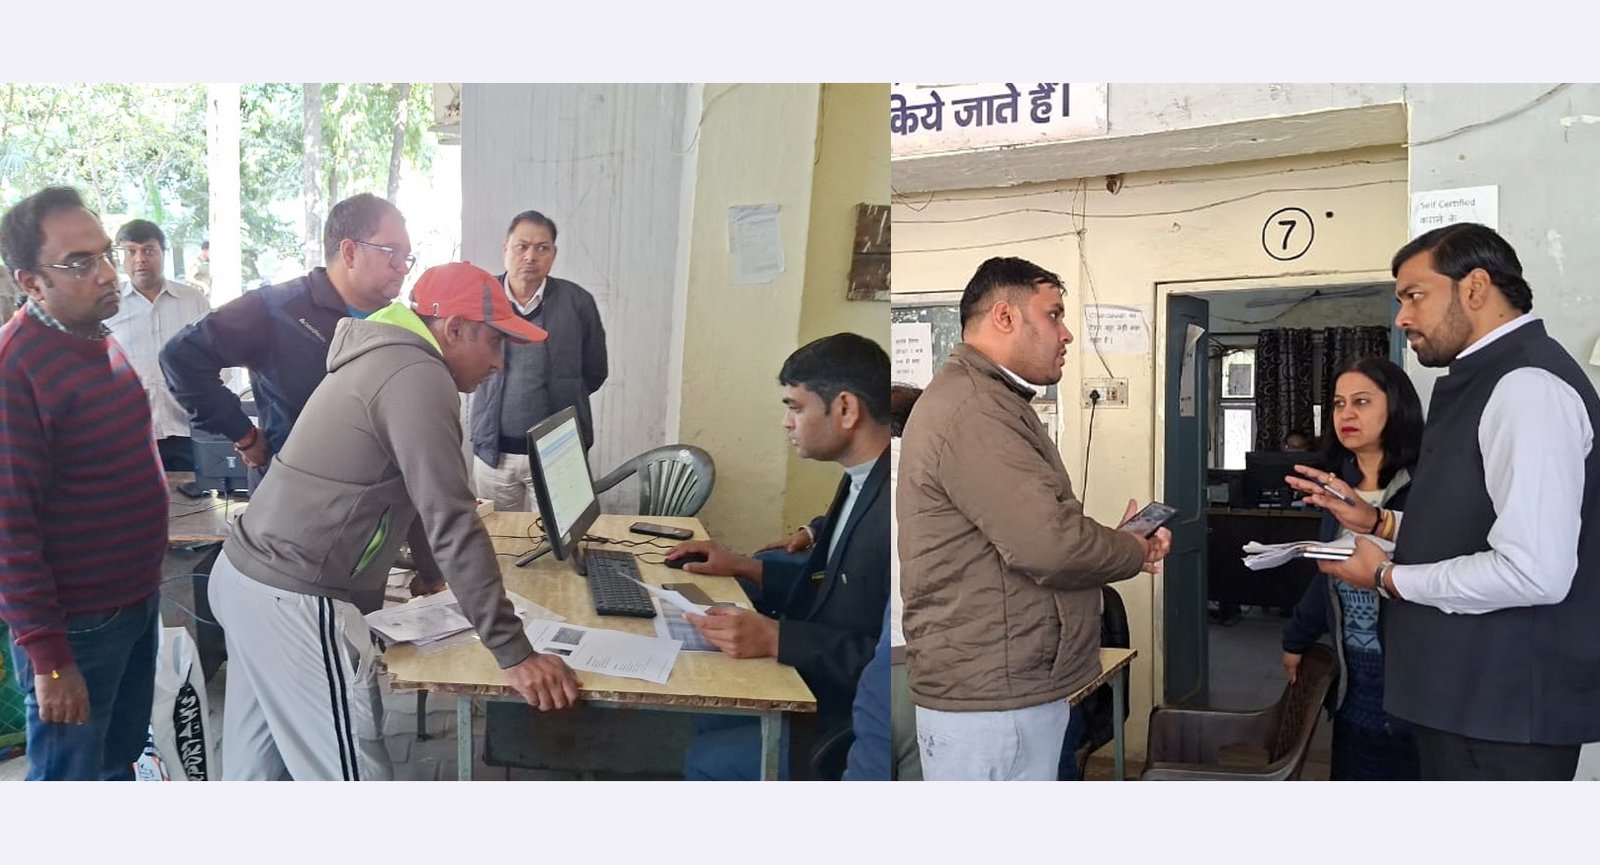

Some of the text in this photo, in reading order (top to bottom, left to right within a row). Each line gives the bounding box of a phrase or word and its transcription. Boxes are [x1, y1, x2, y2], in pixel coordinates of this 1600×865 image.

[951, 83, 1021, 127] जाते
[1420, 198, 1476, 209] Self Certified
[1278, 220, 1296, 250] 7
